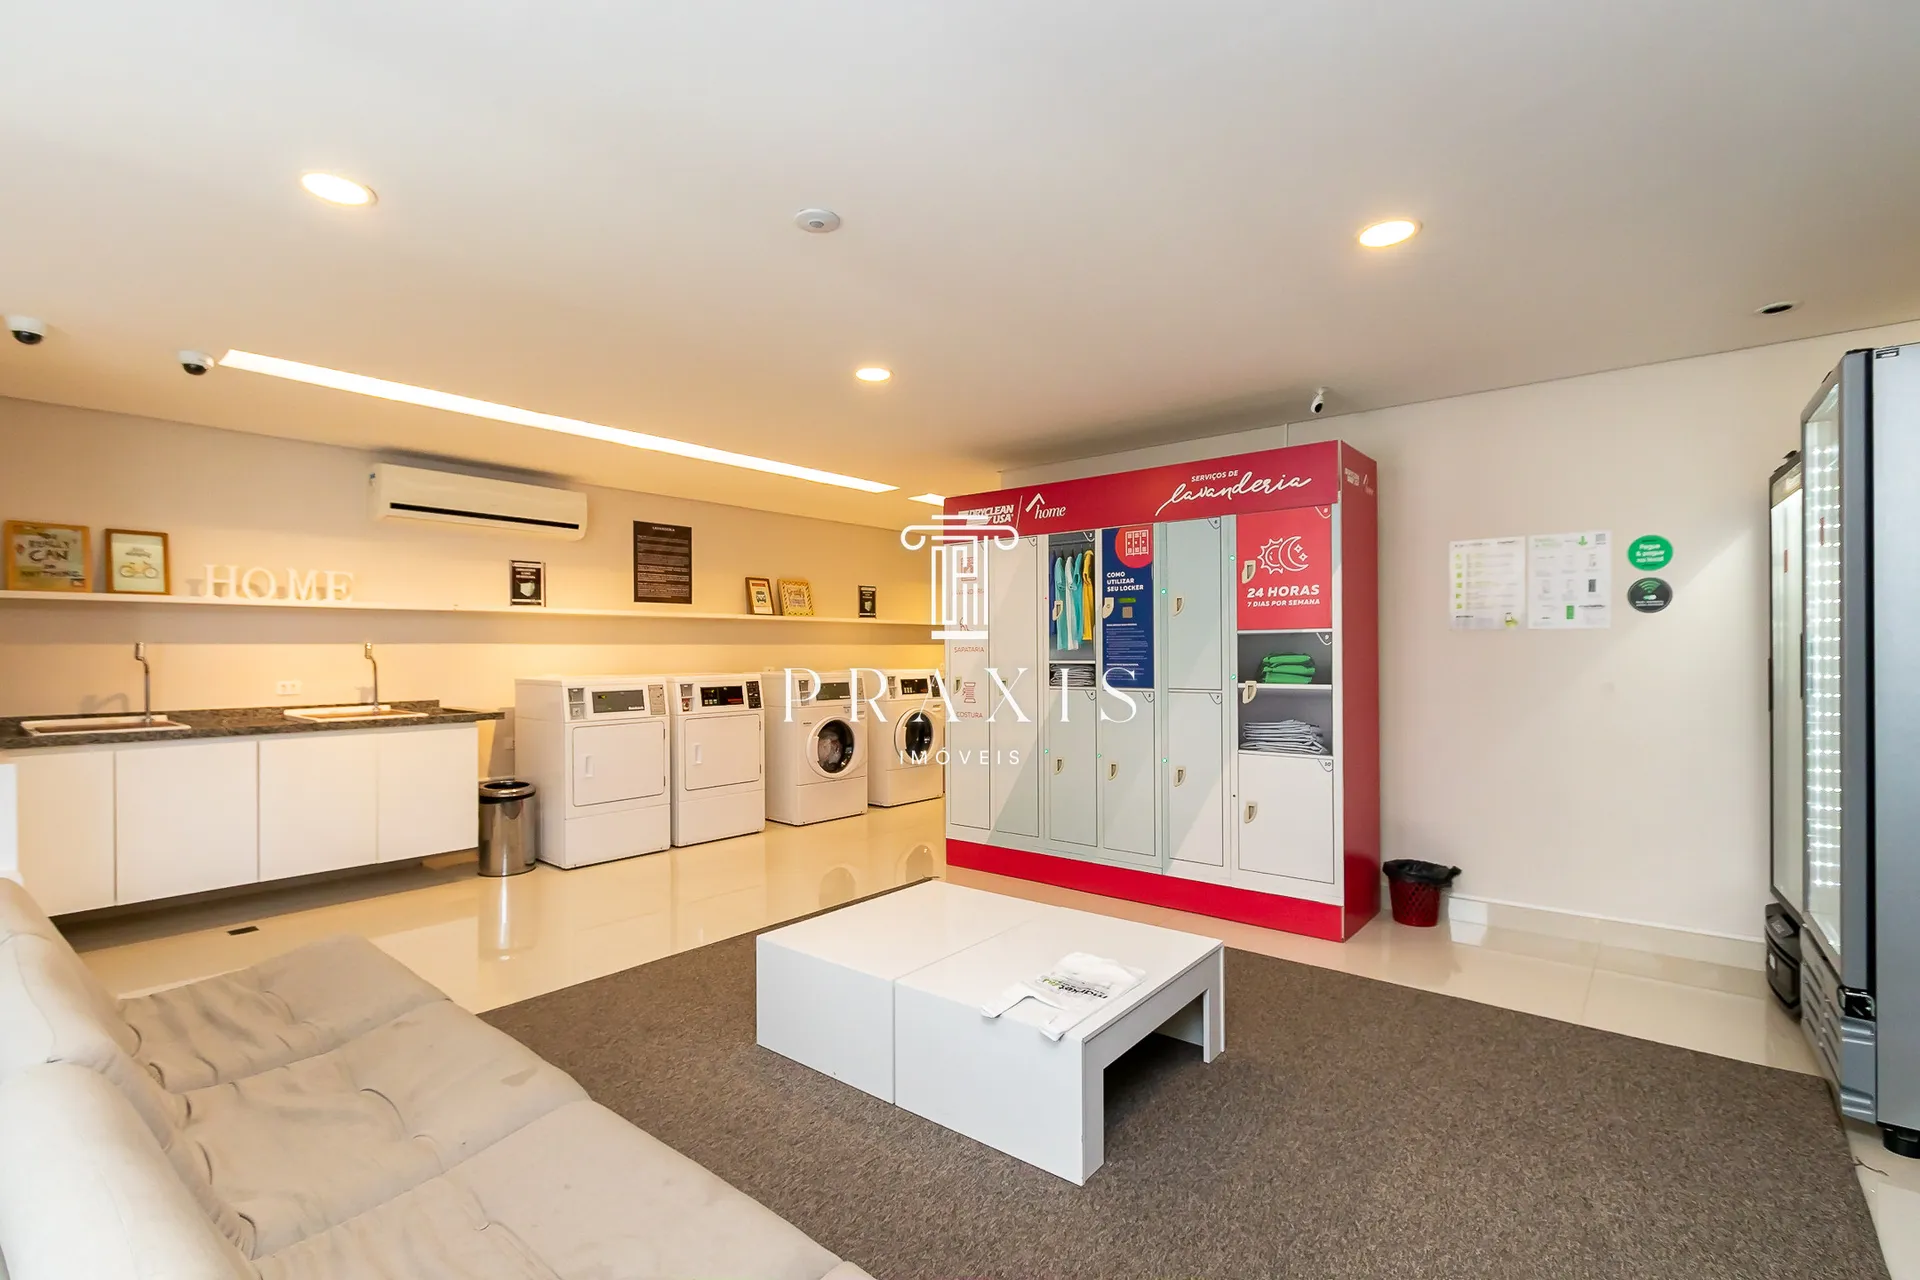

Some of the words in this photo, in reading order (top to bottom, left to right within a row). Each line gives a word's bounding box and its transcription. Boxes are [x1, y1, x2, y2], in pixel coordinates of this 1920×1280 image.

[1191, 472, 1227, 482] SERVIÇOS
[1155, 471, 1312, 516] lavanderia
[1034, 504, 1067, 520] home
[202, 563, 355, 602] HOME
[1106, 577, 1135, 585] UTILIZAR
[1120, 584, 1144, 592] LOCKER
[1247, 587, 1264, 599] 24
[1267, 584, 1320, 598] HORAS
[1288, 598, 1320, 606] SEMANA
[953, 646, 985, 654] SAPATARIA
[955, 711, 983, 719] COSTURA
